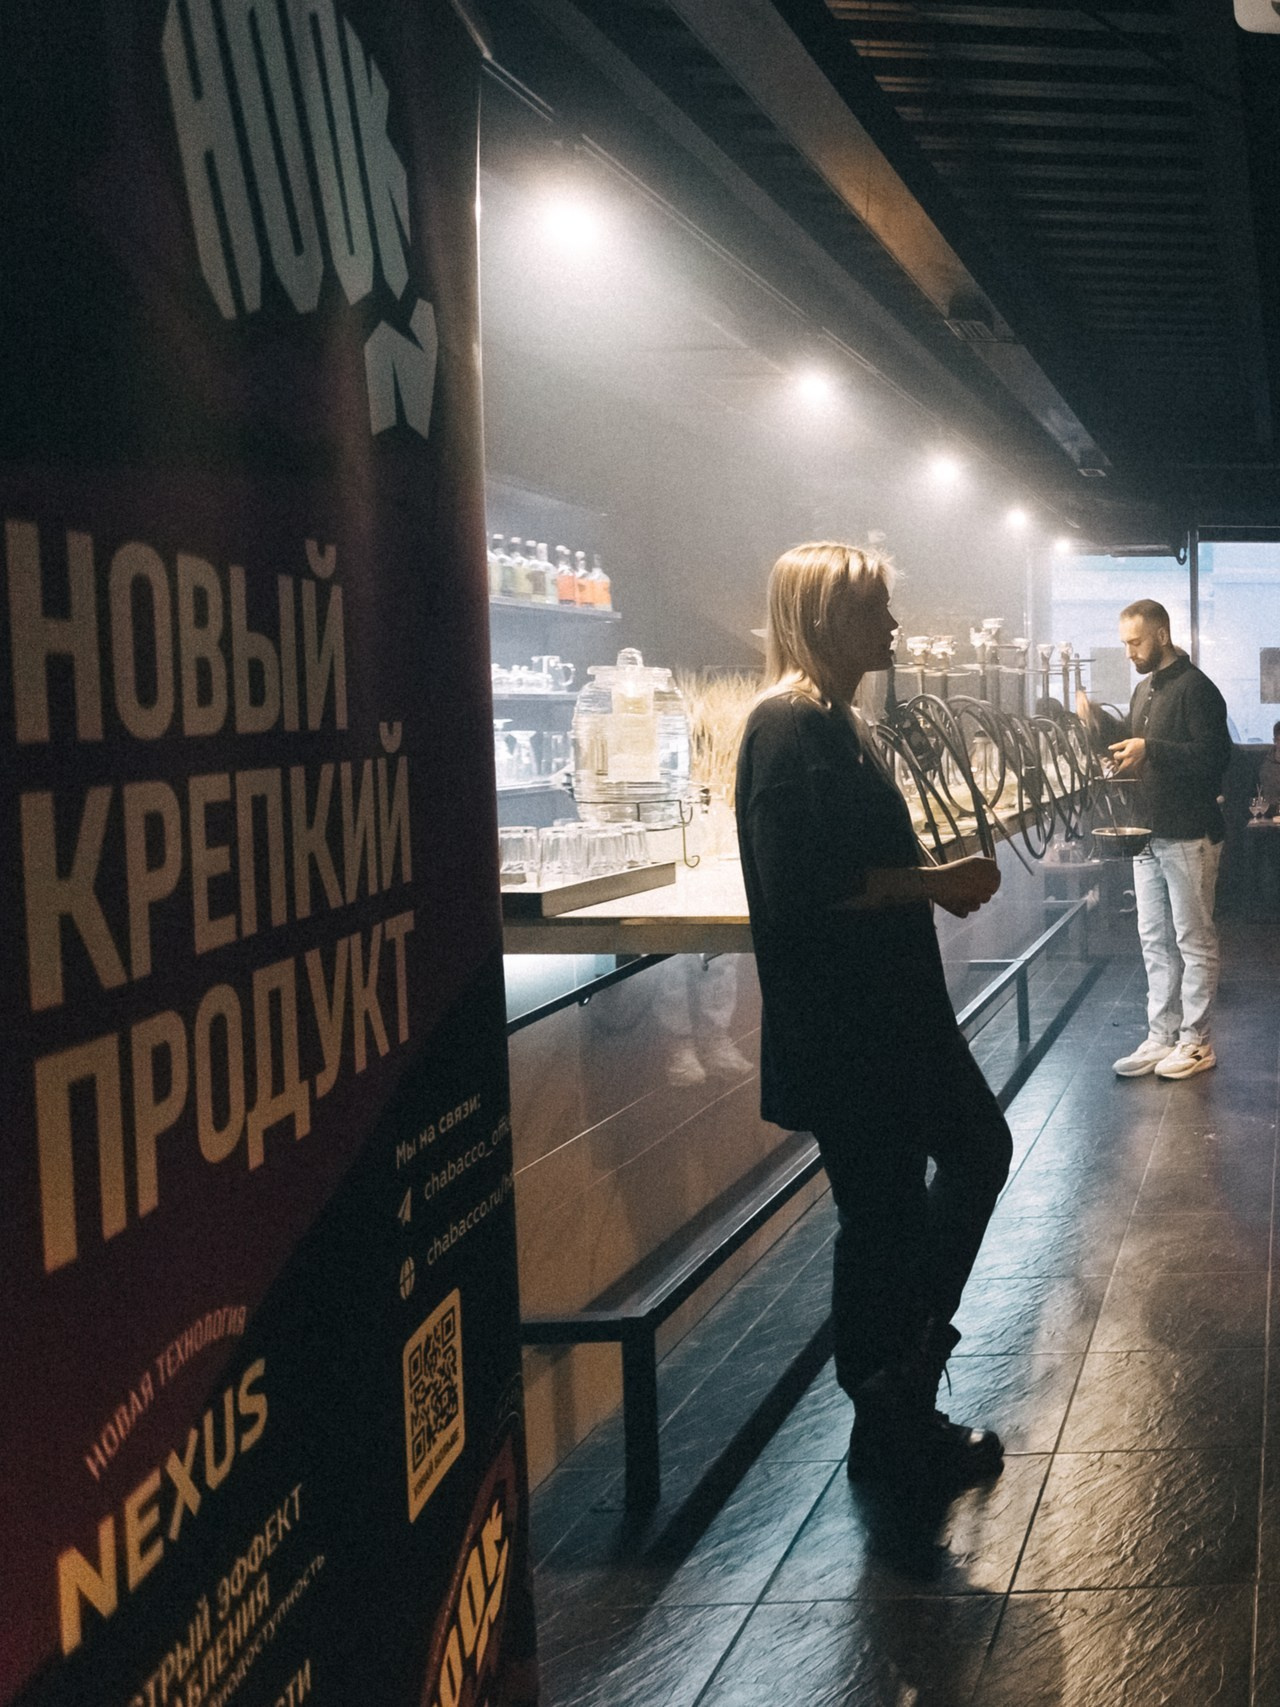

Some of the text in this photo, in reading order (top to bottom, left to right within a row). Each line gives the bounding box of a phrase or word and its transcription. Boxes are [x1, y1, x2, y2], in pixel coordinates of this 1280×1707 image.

[5, 519, 348, 744] НОВЫЙ
[20, 721, 413, 1012] КРЕПКИЙ
[33, 909, 414, 1275] ПРОДУКТ
[396, 1093, 481, 1170] Мы на связи:
[85, 1306, 247, 1481] НОВАЯ ТЕХНОЛОГИЯ
[57, 1358, 268, 1657] NEXUS
[217, 1482, 302, 1621] ЭФФЕКТ
[174, 1571, 269, 1707] БЛЕНИЯ
